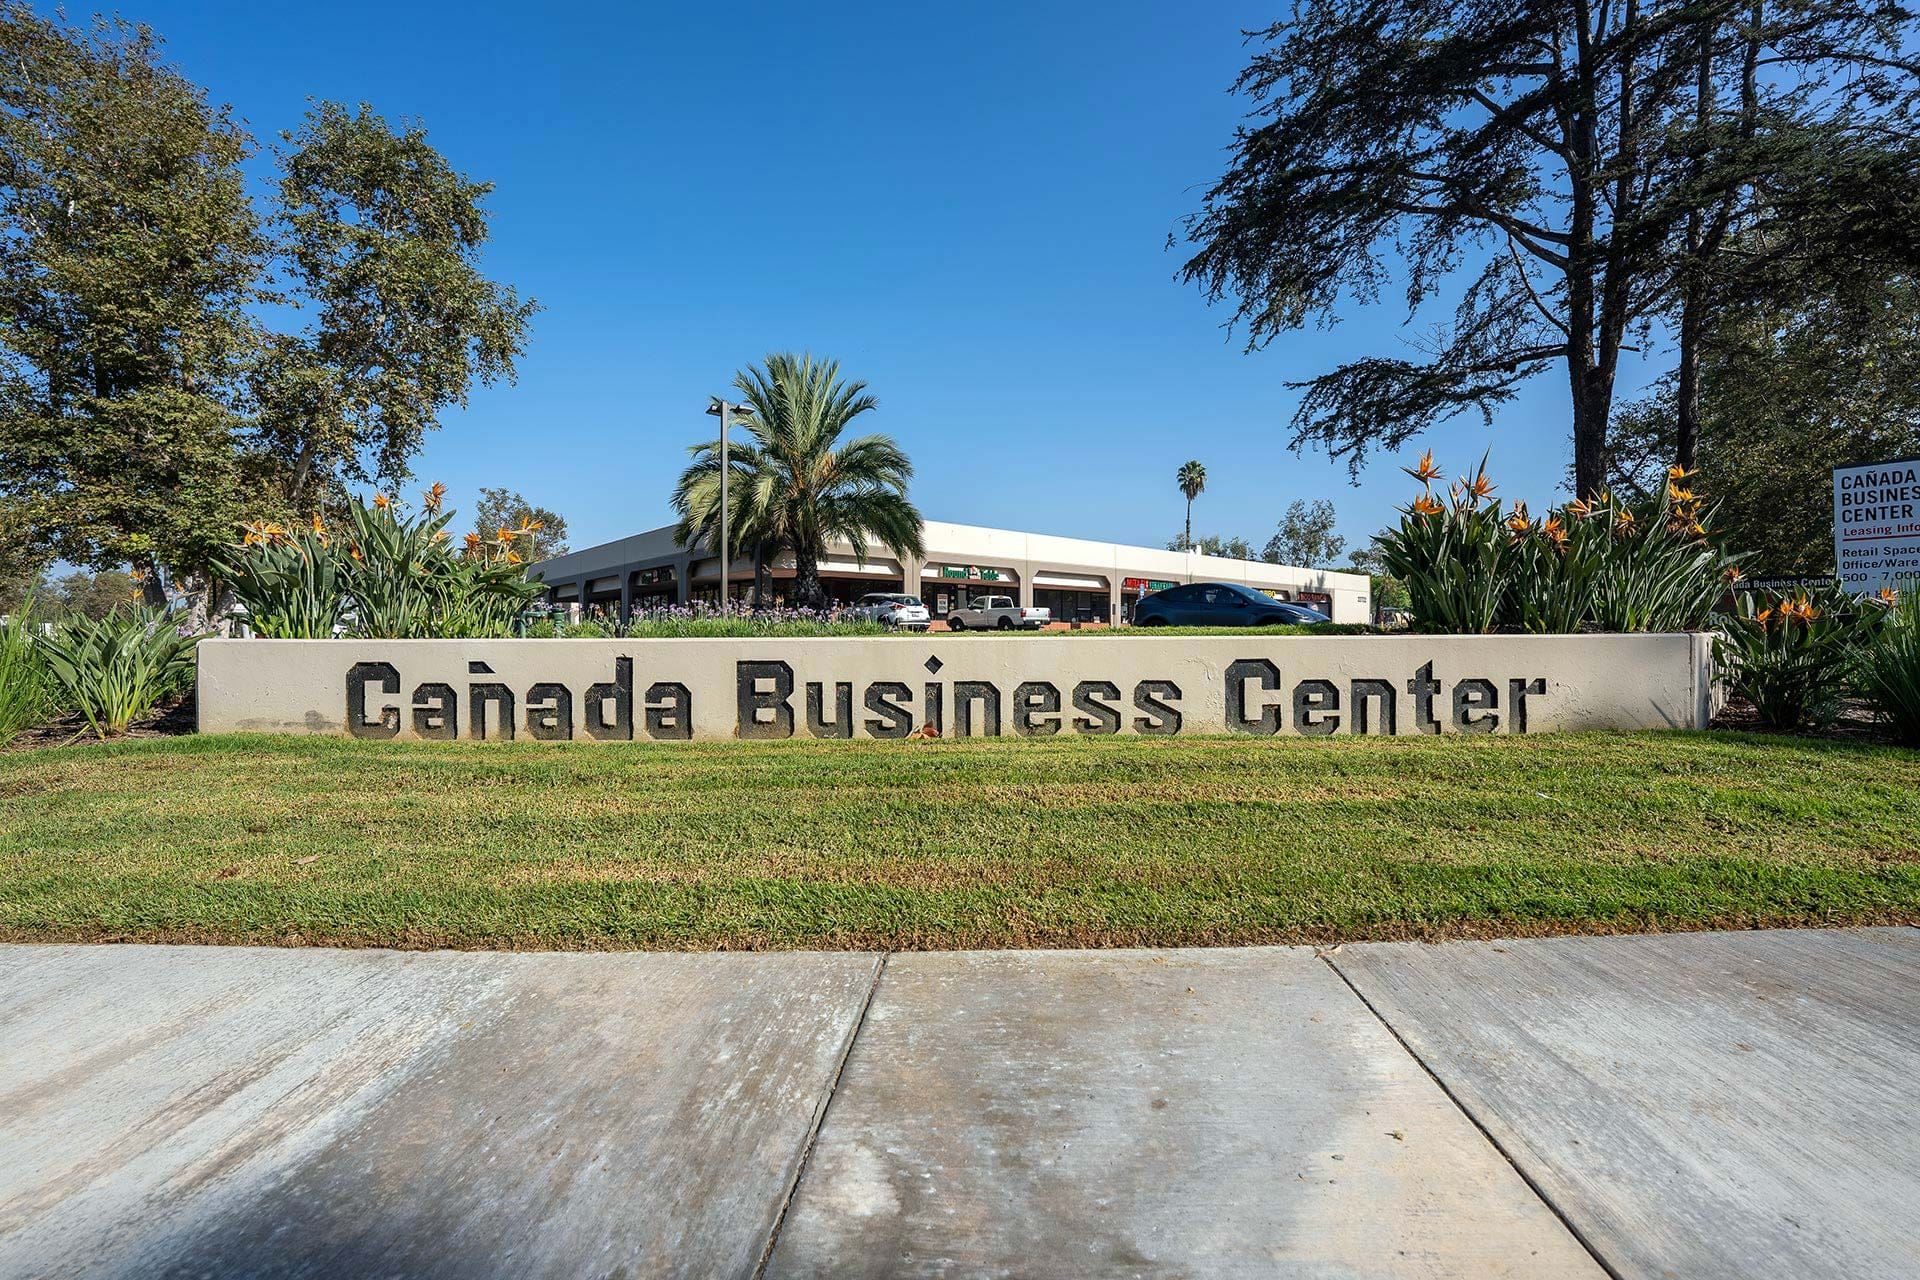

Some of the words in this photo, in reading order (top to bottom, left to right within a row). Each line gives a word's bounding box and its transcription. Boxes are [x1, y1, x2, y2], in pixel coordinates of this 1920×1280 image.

[1841, 469, 1916, 490] CAÑADA
[1842, 504, 1913, 523] CENTER
[1843, 525, 1892, 537] Leasing
[1842, 547, 1879, 558] Retail
[1842, 559, 1919, 570] Office/Ware
[943, 565, 968, 579] Round
[1842, 573, 1868, 582] 500
[345, 656, 693, 741] Cañada
[736, 654, 1183, 740] Business
[1224, 658, 1547, 736] Center
